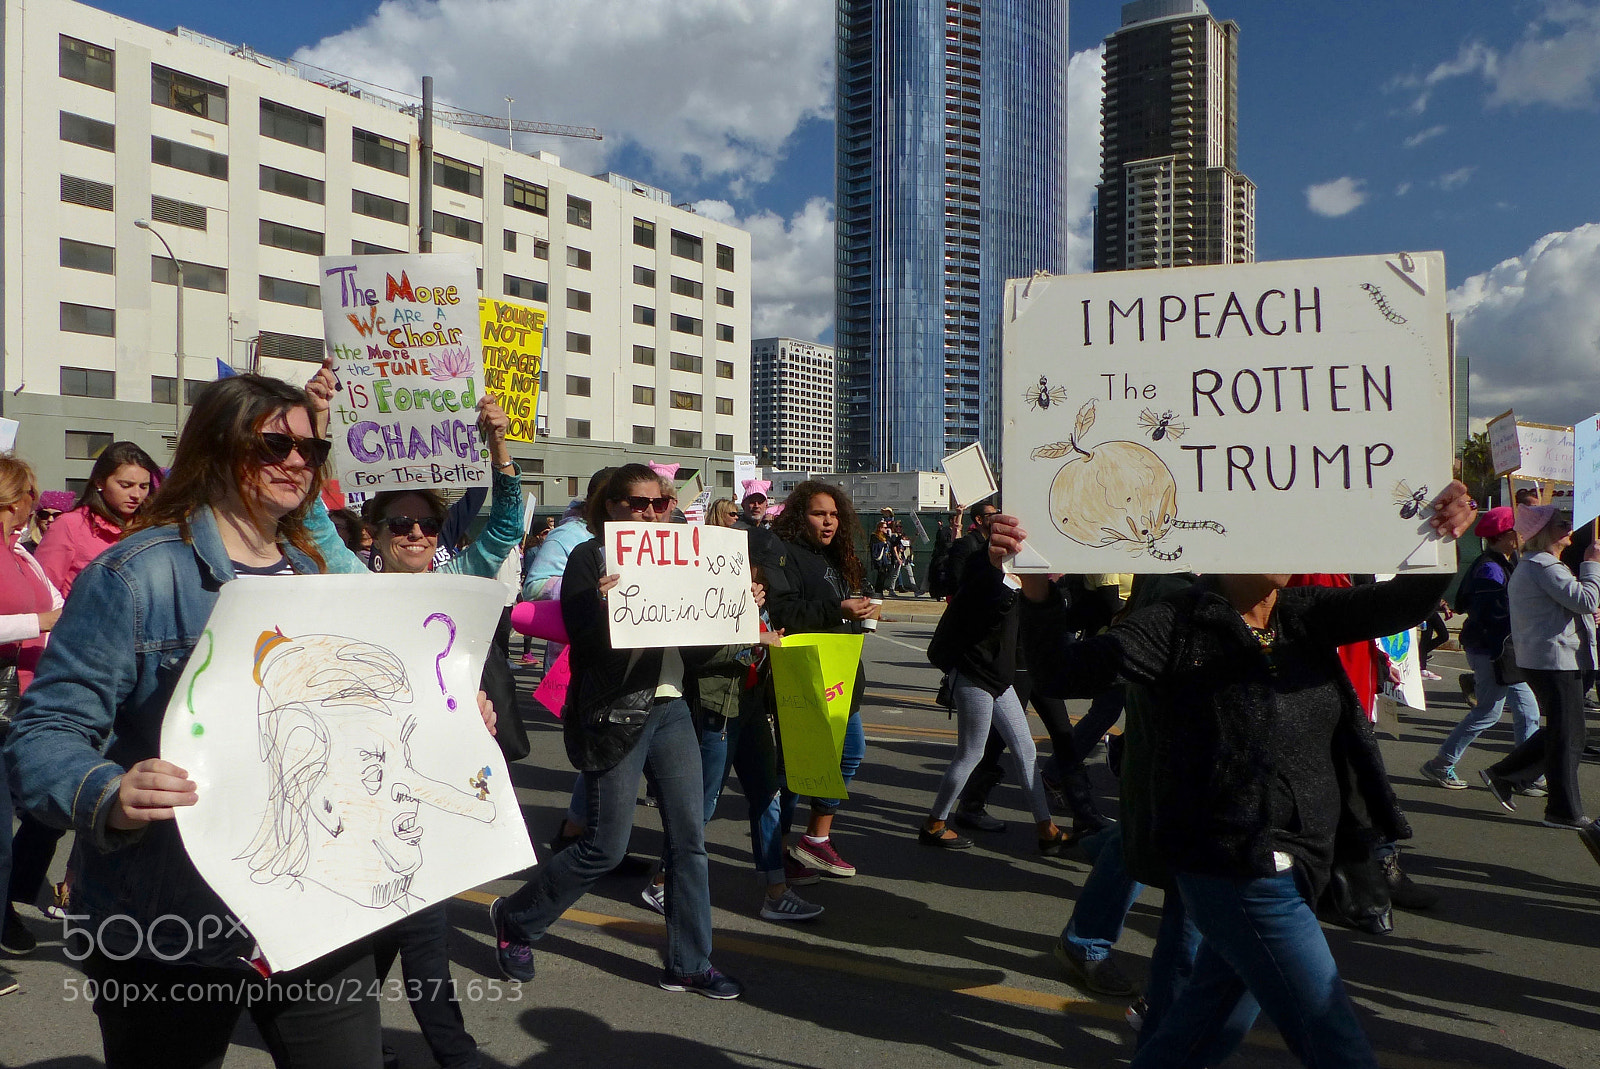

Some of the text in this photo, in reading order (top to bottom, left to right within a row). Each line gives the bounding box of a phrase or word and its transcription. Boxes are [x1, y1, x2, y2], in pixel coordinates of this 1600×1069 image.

[325, 264, 379, 307] The
[346, 305, 388, 338] We
[436, 307, 447, 321] A
[483, 320, 531, 347] NOT
[1082, 286, 1322, 346] IMPEACH
[334, 342, 363, 360] the
[346, 358, 433, 377] the TUNE
[372, 376, 477, 413] Forced
[510, 373, 540, 395] NOT
[1100, 364, 1394, 417] The ROTTEN
[335, 404, 358, 425] to
[355, 463, 485, 485] For The Better
[1180, 443, 1394, 492] TRUMP
[616, 526, 744, 576] FAIL! to the
[613, 584, 747, 633] Liar-in-Chief
